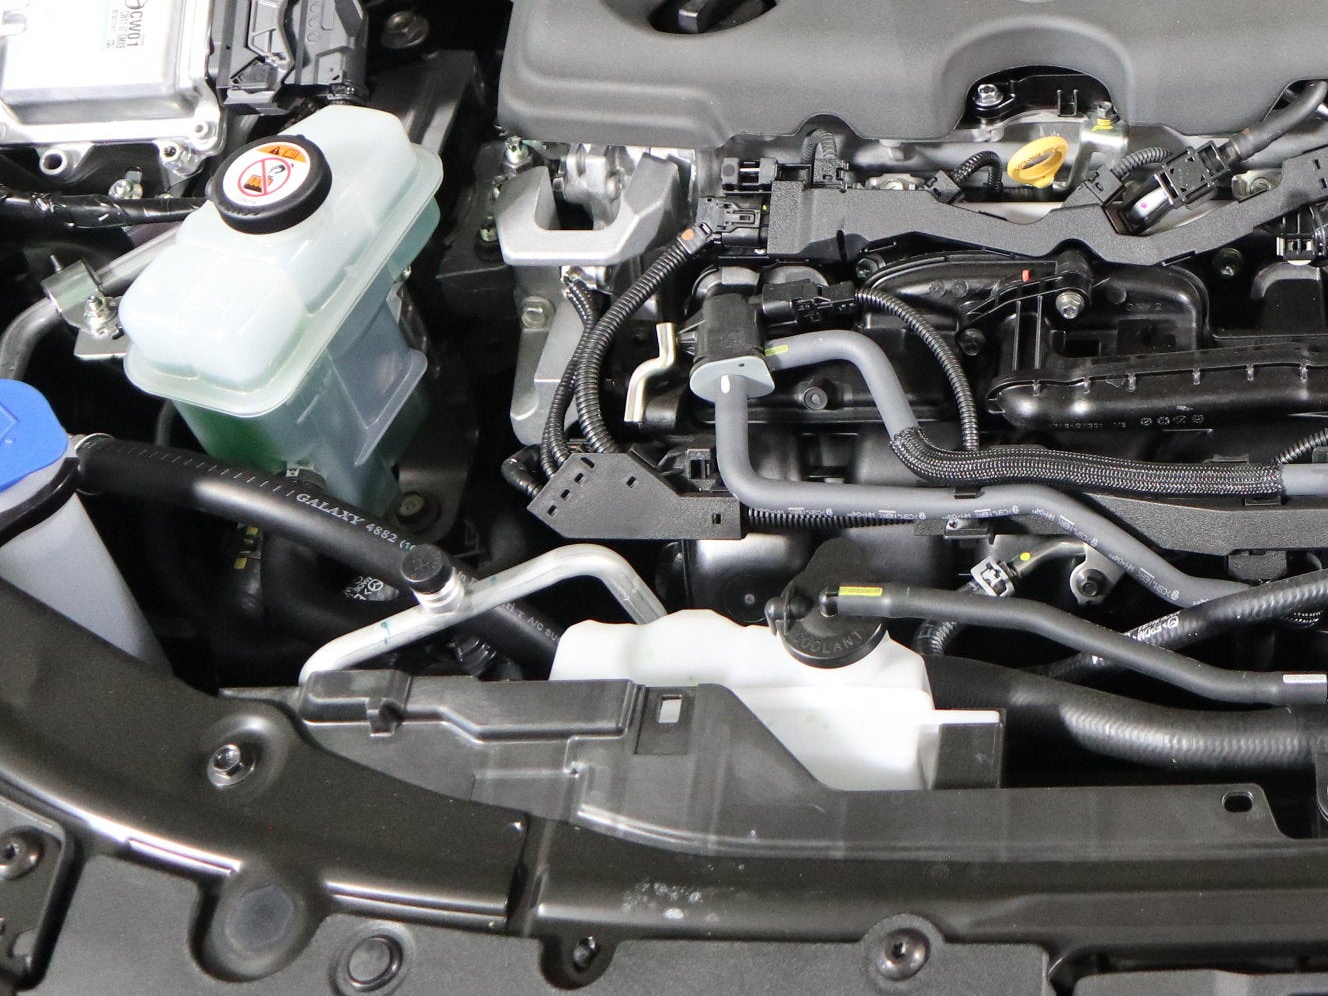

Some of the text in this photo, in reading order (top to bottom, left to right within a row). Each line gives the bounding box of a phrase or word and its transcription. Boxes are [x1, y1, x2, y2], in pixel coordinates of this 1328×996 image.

[127, 11, 143, 47] CW01
[296, 493, 366, 525] GALAXY
[365, 523, 398, 543] 4882
[527, 617, 544, 631] A/C
[788, 630, 864, 654] COOLANT
